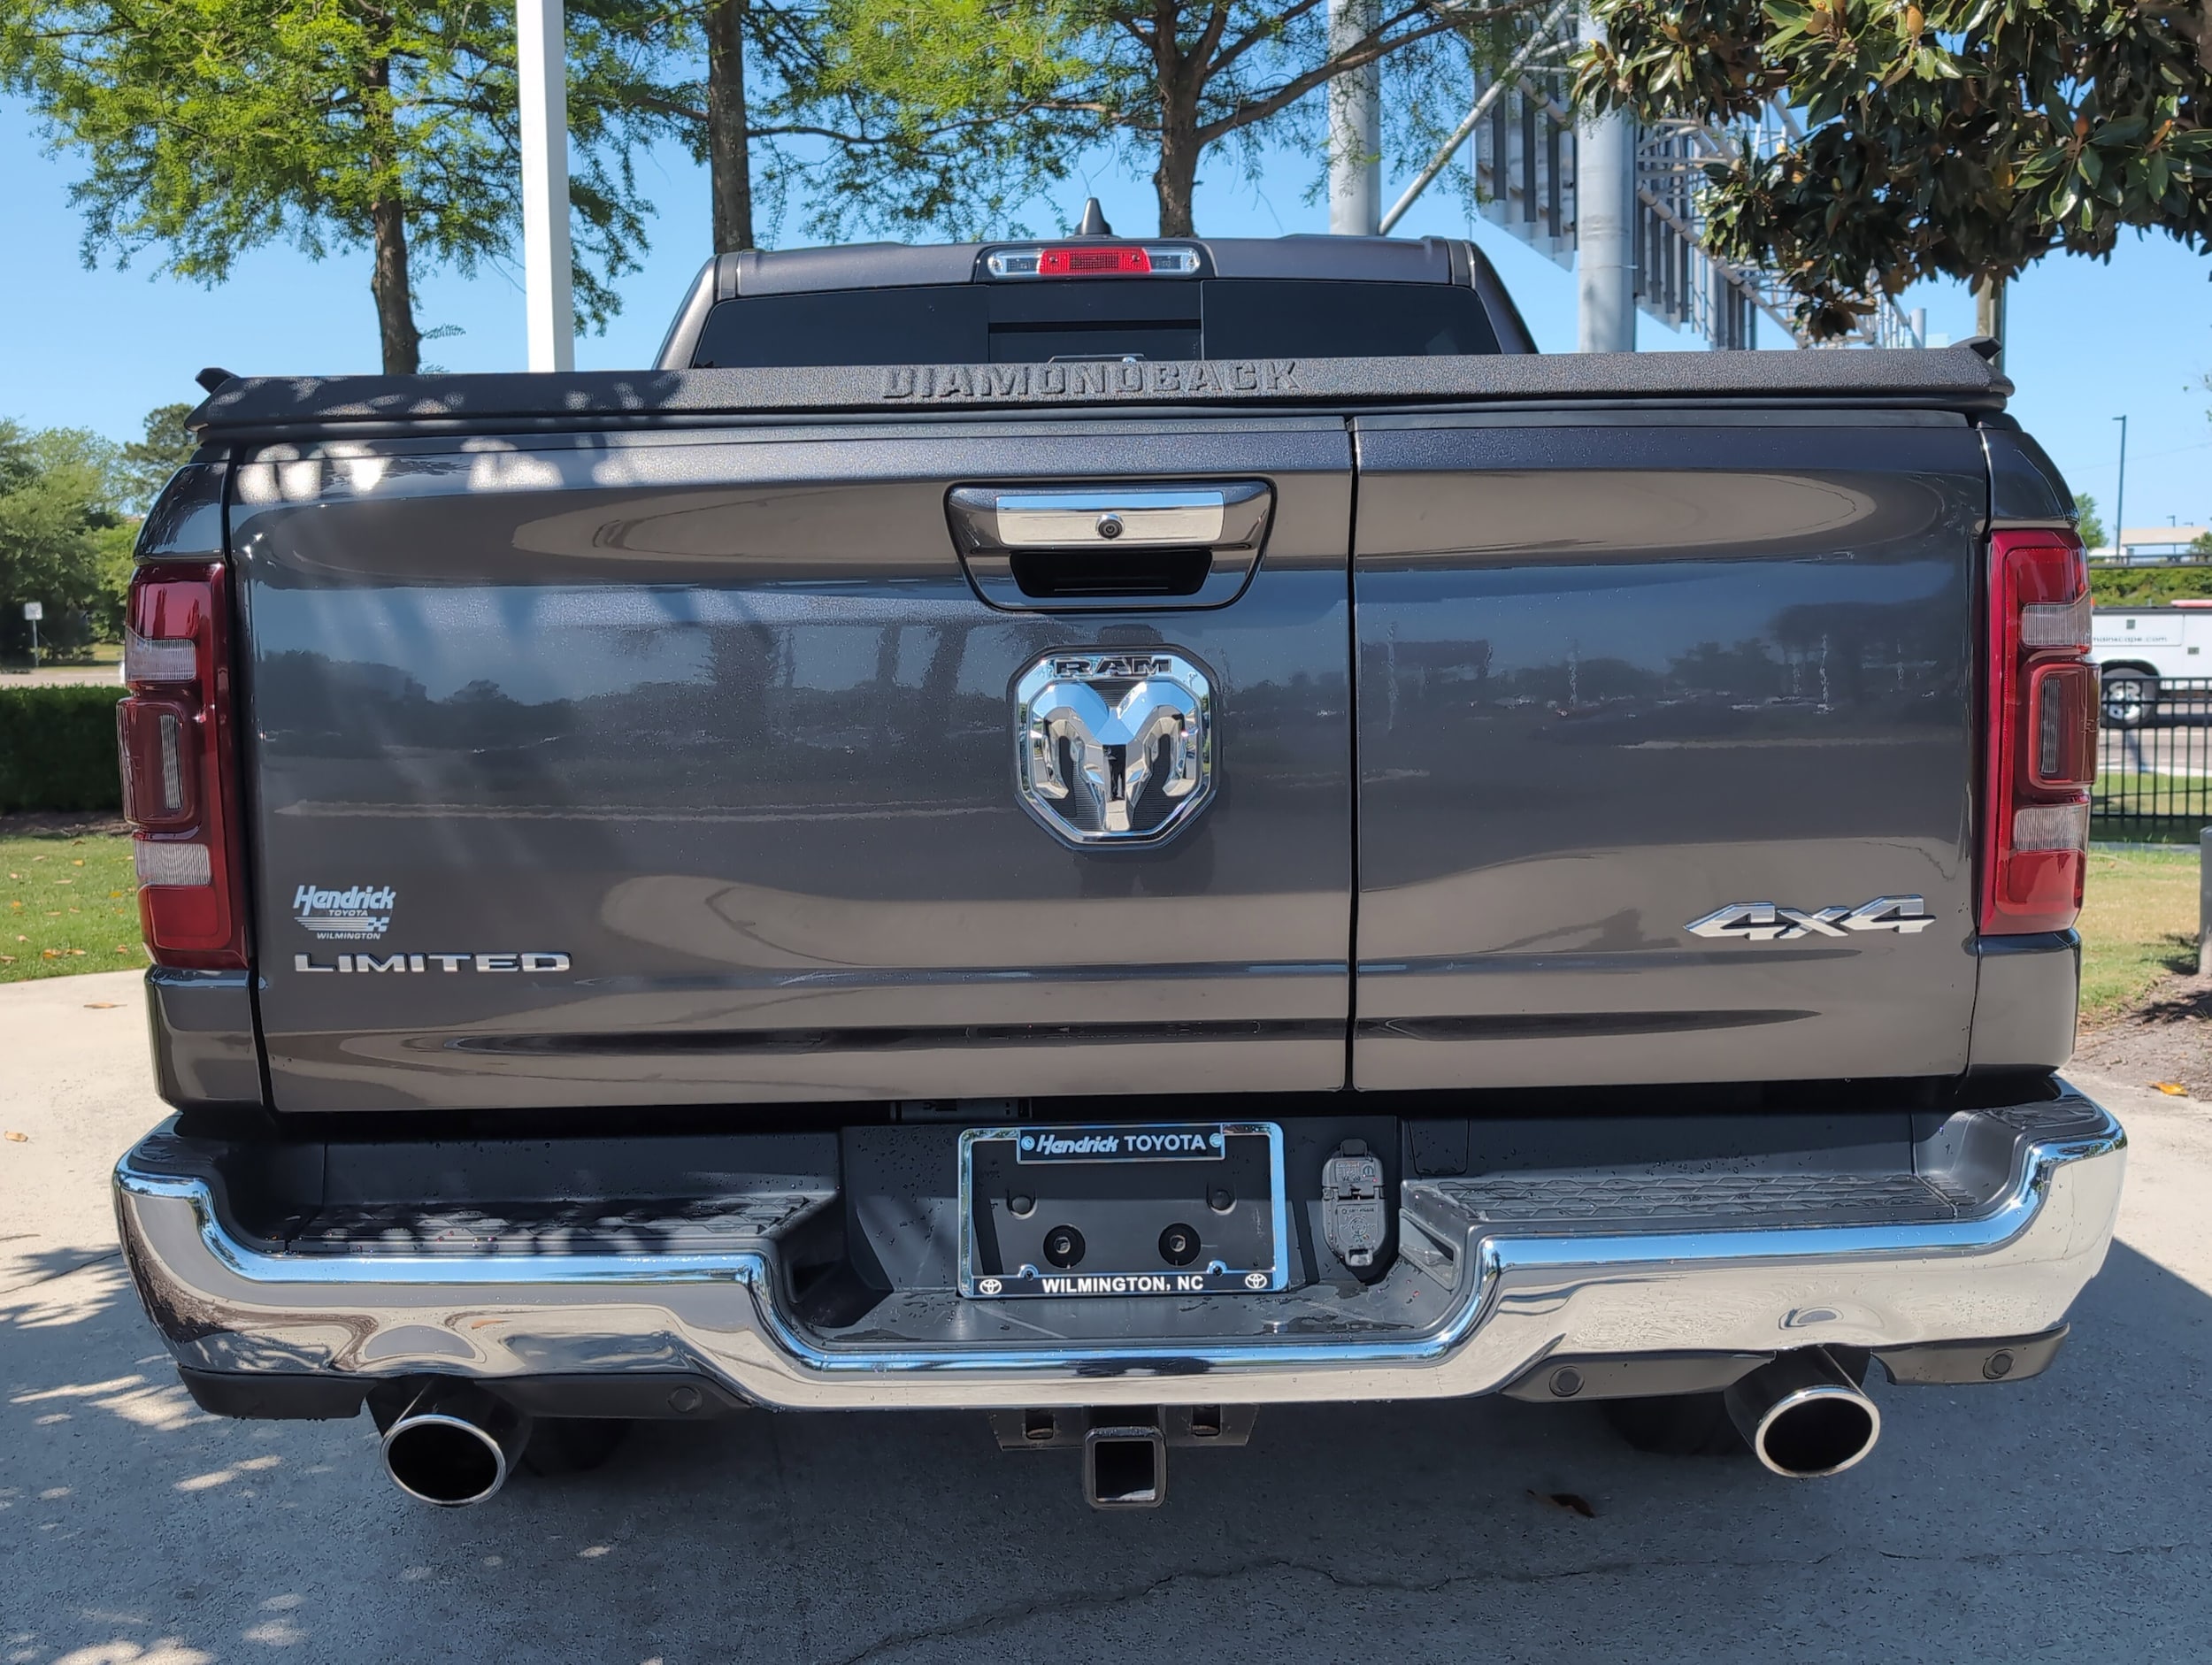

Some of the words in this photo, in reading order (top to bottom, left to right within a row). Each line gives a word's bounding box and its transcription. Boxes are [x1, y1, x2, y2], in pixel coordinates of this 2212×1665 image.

[883, 360, 1302, 398] DIAMONDBACK
[1054, 657, 1172, 677] RAM
[293, 885, 397, 916] Hendrick
[316, 932, 381, 940] WILMINGTON
[294, 952, 572, 973] LIMITED
[1036, 1133, 1119, 1155] Hendrick
[1124, 1134, 1207, 1152] TOYOTA
[1041, 1277, 1171, 1293] WILMINGTON,
[1177, 1275, 1204, 1290] NC
